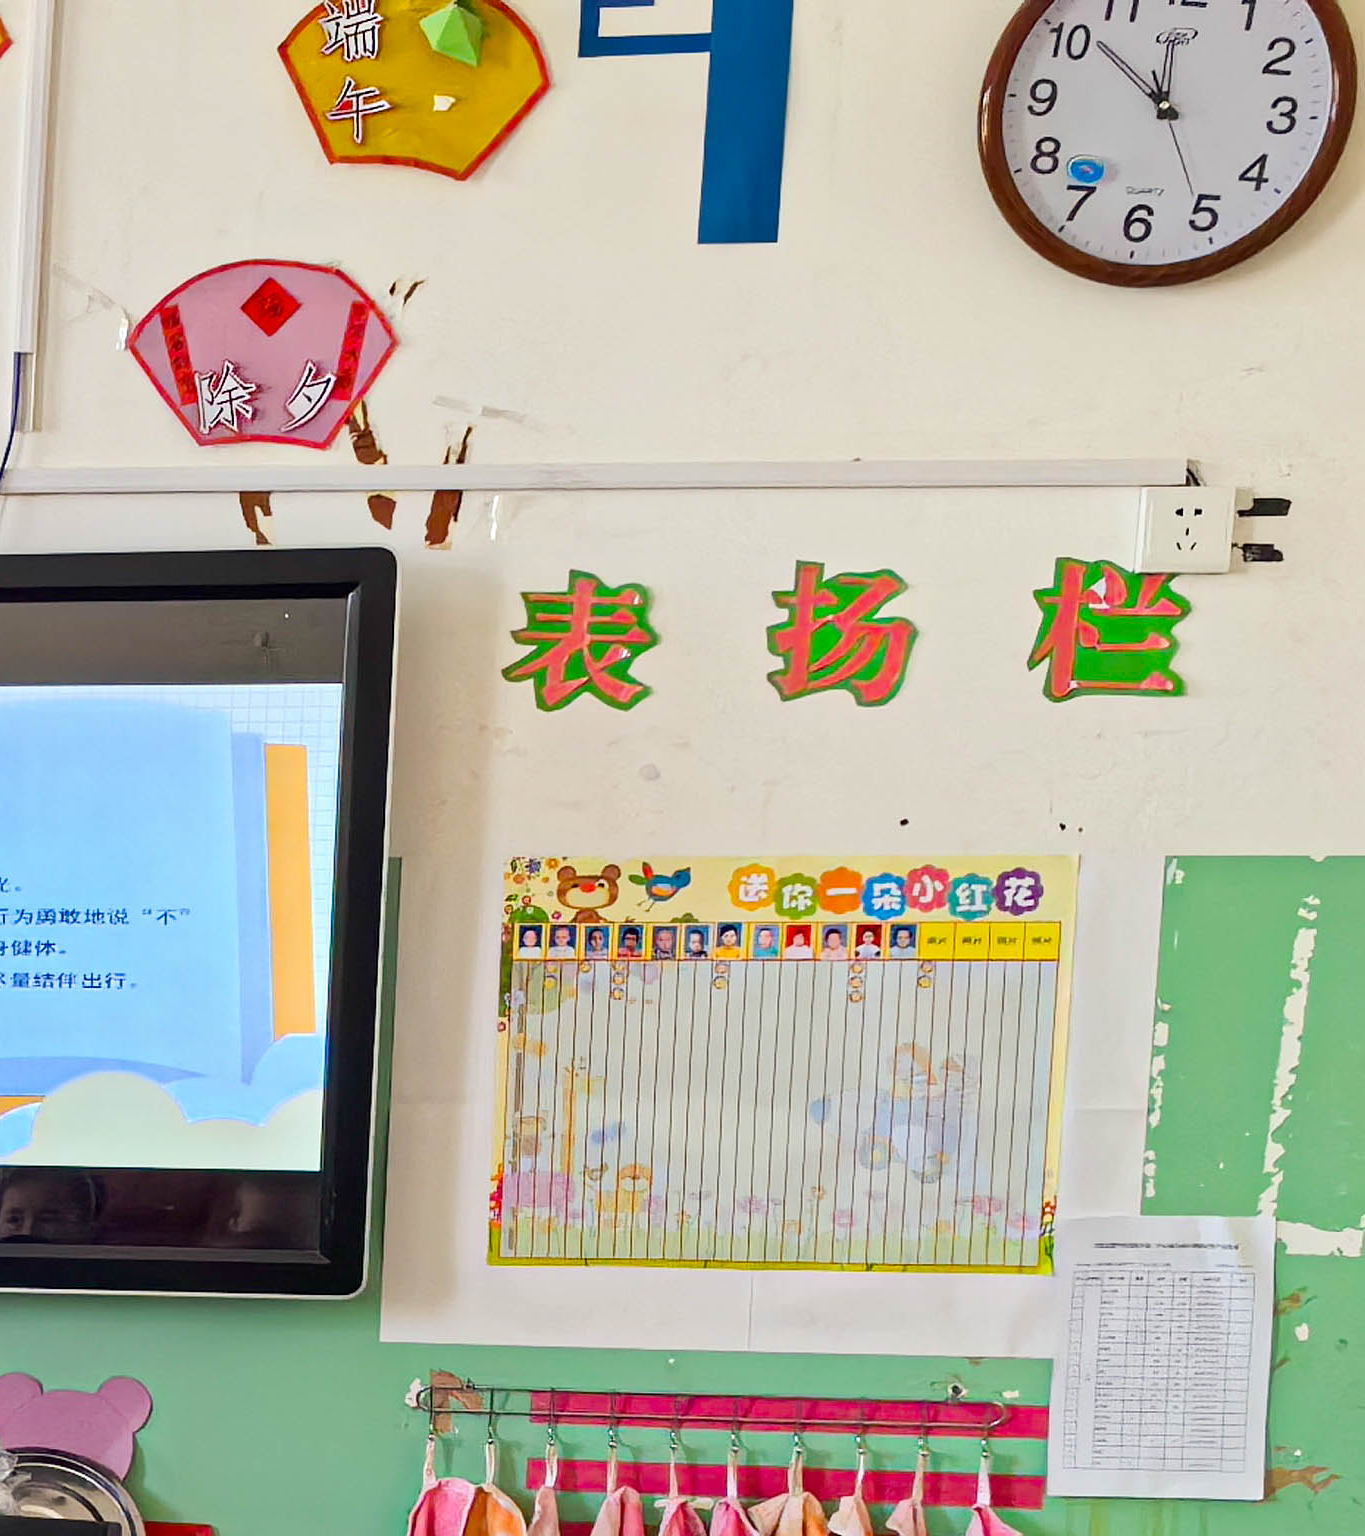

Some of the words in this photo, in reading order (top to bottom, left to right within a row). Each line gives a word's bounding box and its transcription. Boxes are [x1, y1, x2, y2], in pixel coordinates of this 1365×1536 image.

[1240, 0, 1257, 31] 1
[1049, 23, 1092, 61] 10
[1261, 37, 1297, 76] 2
[319, 0, 391, 144] 端午
[1027, 78, 1059, 116] 9
[1265, 96, 1299, 135] 3
[1029, 136, 1061, 175] 8
[1237, 153, 1270, 192] 4
[1065, 185, 1098, 222] 7
[1187, 193, 1222, 232] 5
[1122, 204, 1155, 243] 6
[195, 359, 336, 434] 除夕
[502, 557, 1191, 708] 表扬栏
[738, 871, 1038, 915] 送你一朵小红花
